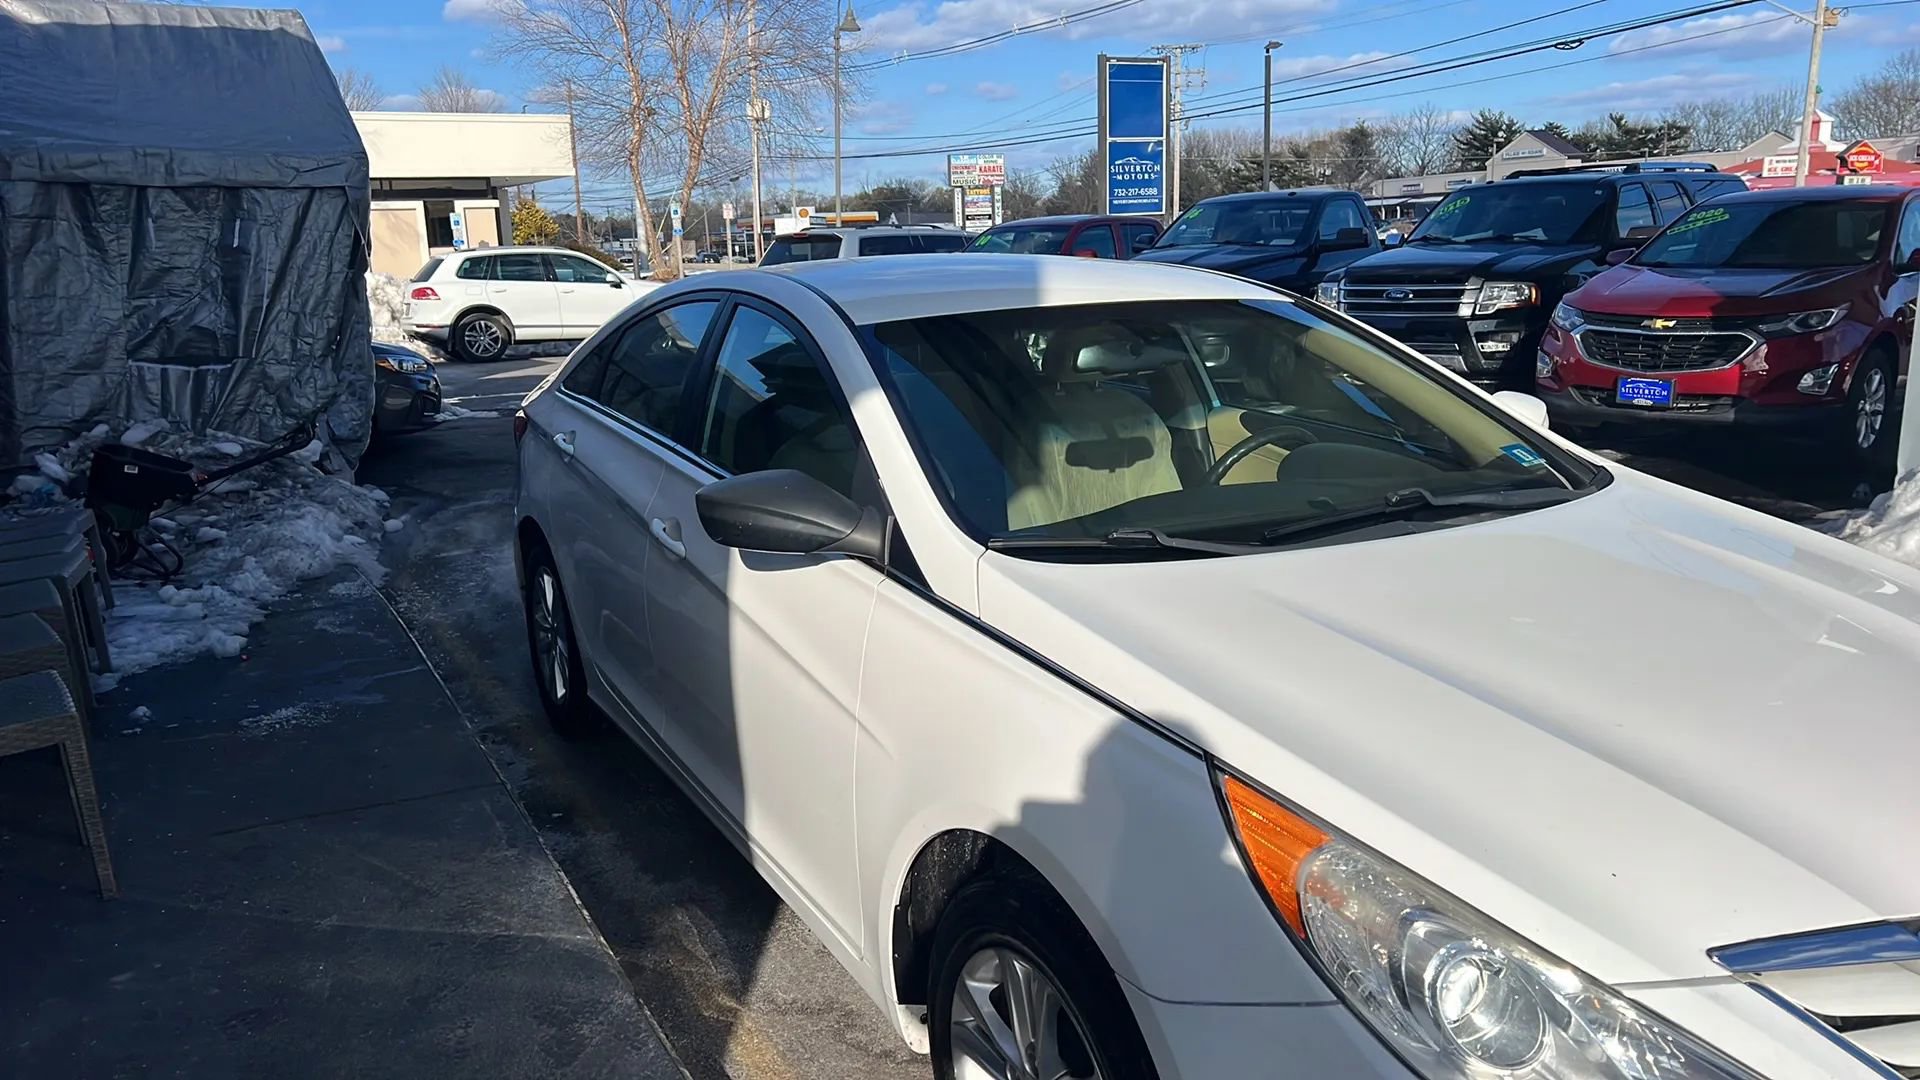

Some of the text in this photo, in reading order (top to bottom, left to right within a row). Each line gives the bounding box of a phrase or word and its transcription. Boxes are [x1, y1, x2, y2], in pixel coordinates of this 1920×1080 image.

[979, 165, 1003, 173] KARATE
[1110, 164, 1160, 173] SILVERTON
[1114, 188, 1158, 196] 732-217-6588
[1687, 207, 1724, 222] 2020
[1621, 387, 1668, 396] SILVERTON
